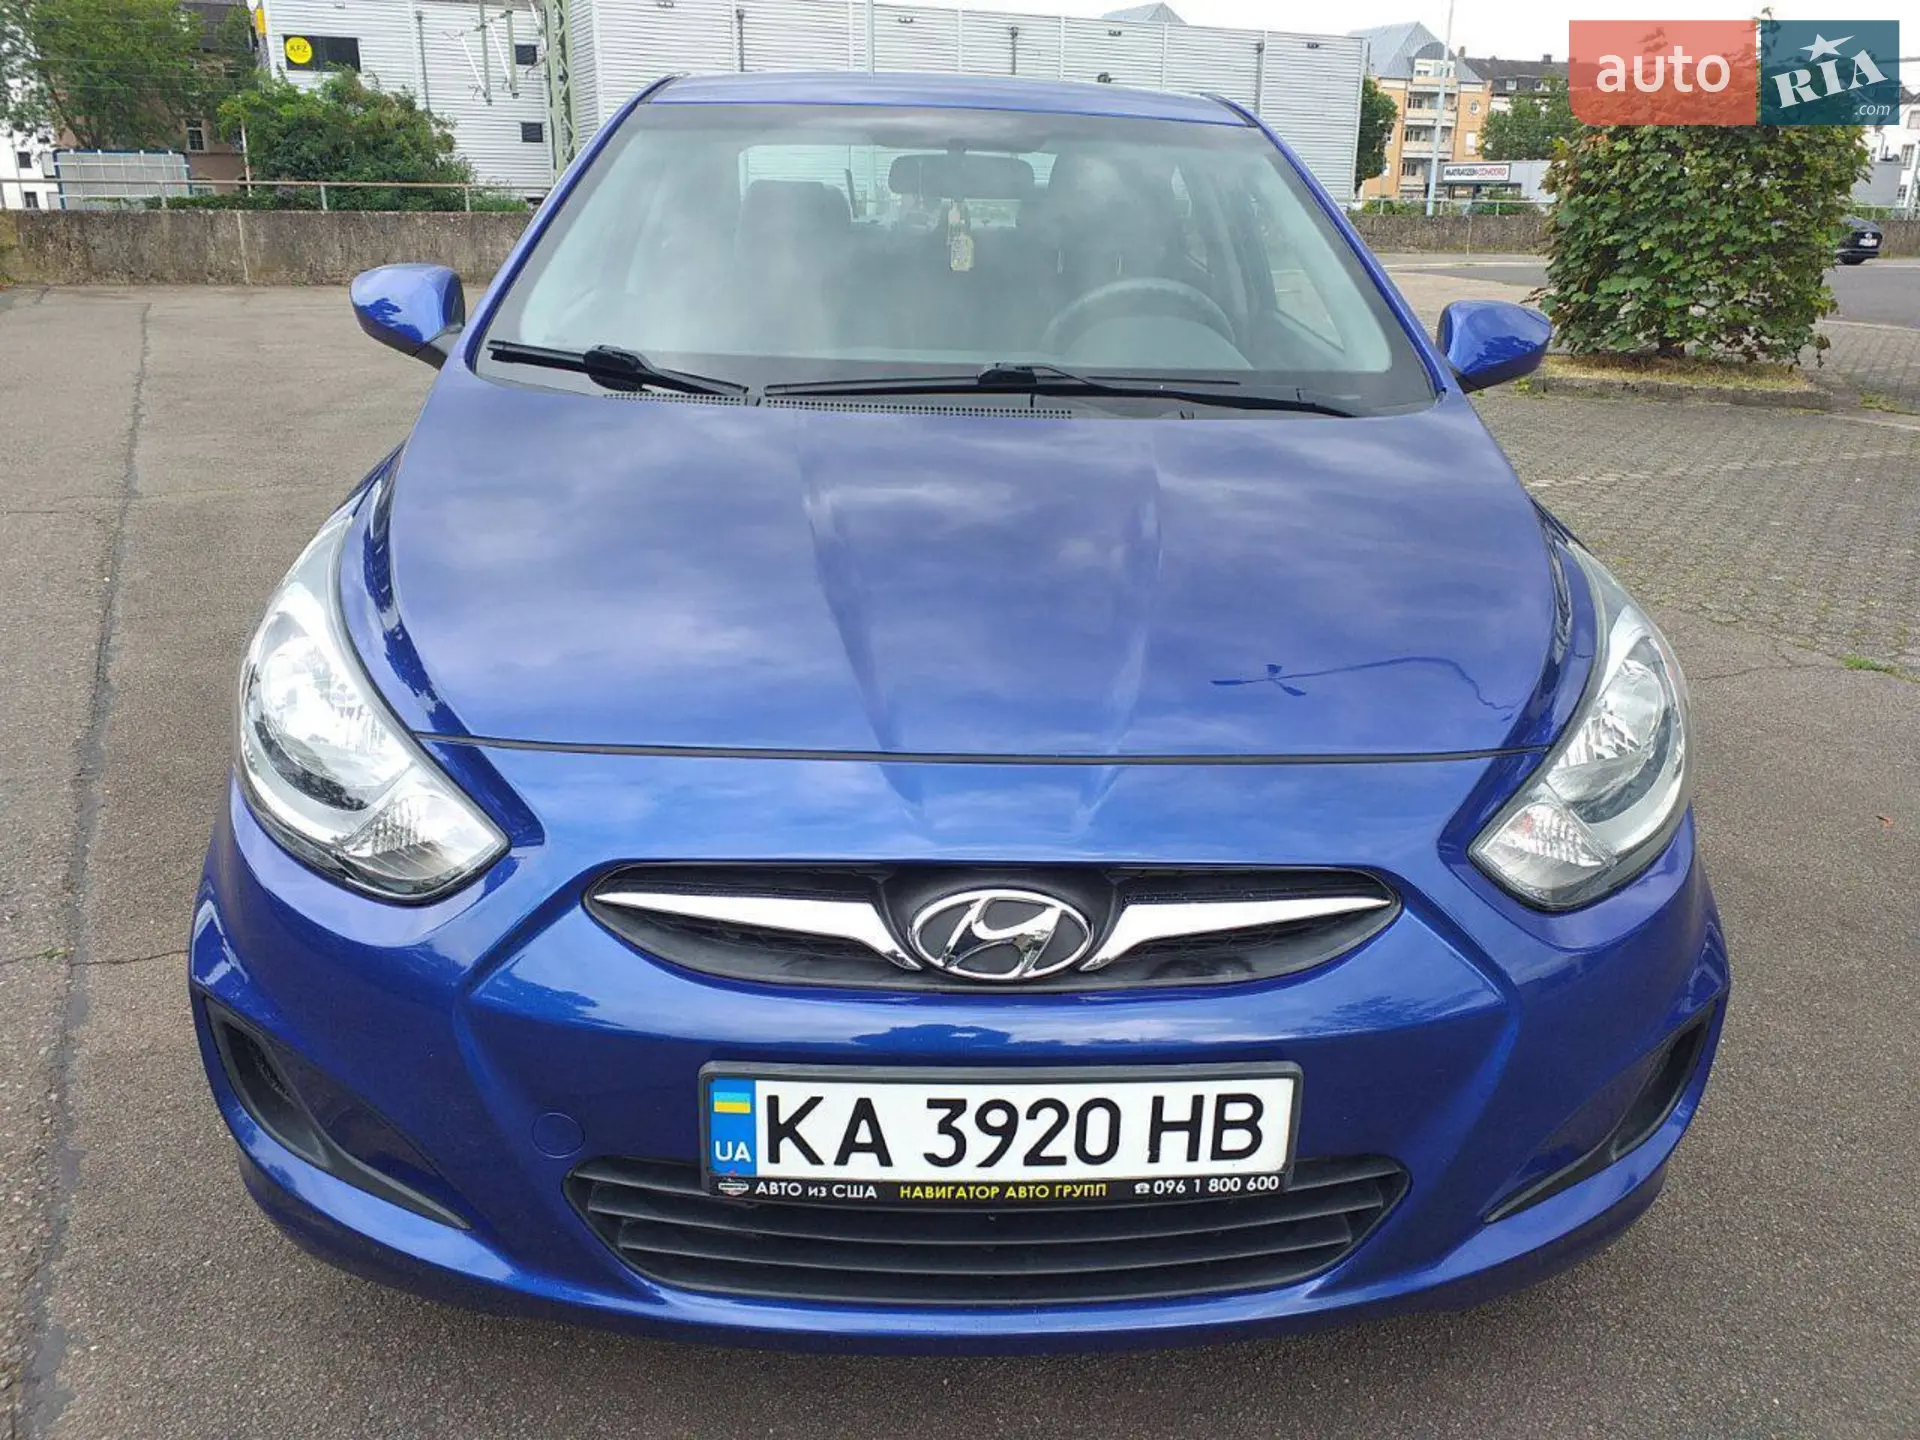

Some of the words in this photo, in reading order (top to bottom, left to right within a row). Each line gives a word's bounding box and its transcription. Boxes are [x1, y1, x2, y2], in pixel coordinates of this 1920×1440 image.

[767, 1095, 893, 1167] KA
[923, 1097, 1121, 1168] 3920
[1147, 1093, 1264, 1163] HB
[715, 1141, 751, 1162] UA
[755, 1182, 802, 1197] АВТО
[808, 1187, 827, 1198] из
[832, 1184, 878, 1199] США
[900, 1185, 1000, 1199] НАВИГАТОР
[1005, 1185, 1049, 1198] АВТО
[1055, 1184, 1107, 1198] ГРУПП
[1153, 1180, 1186, 1195] 096
[1193, 1178, 1201, 1194] 1
[1208, 1177, 1242, 1193] 800
[1246, 1176, 1279, 1191] 600
